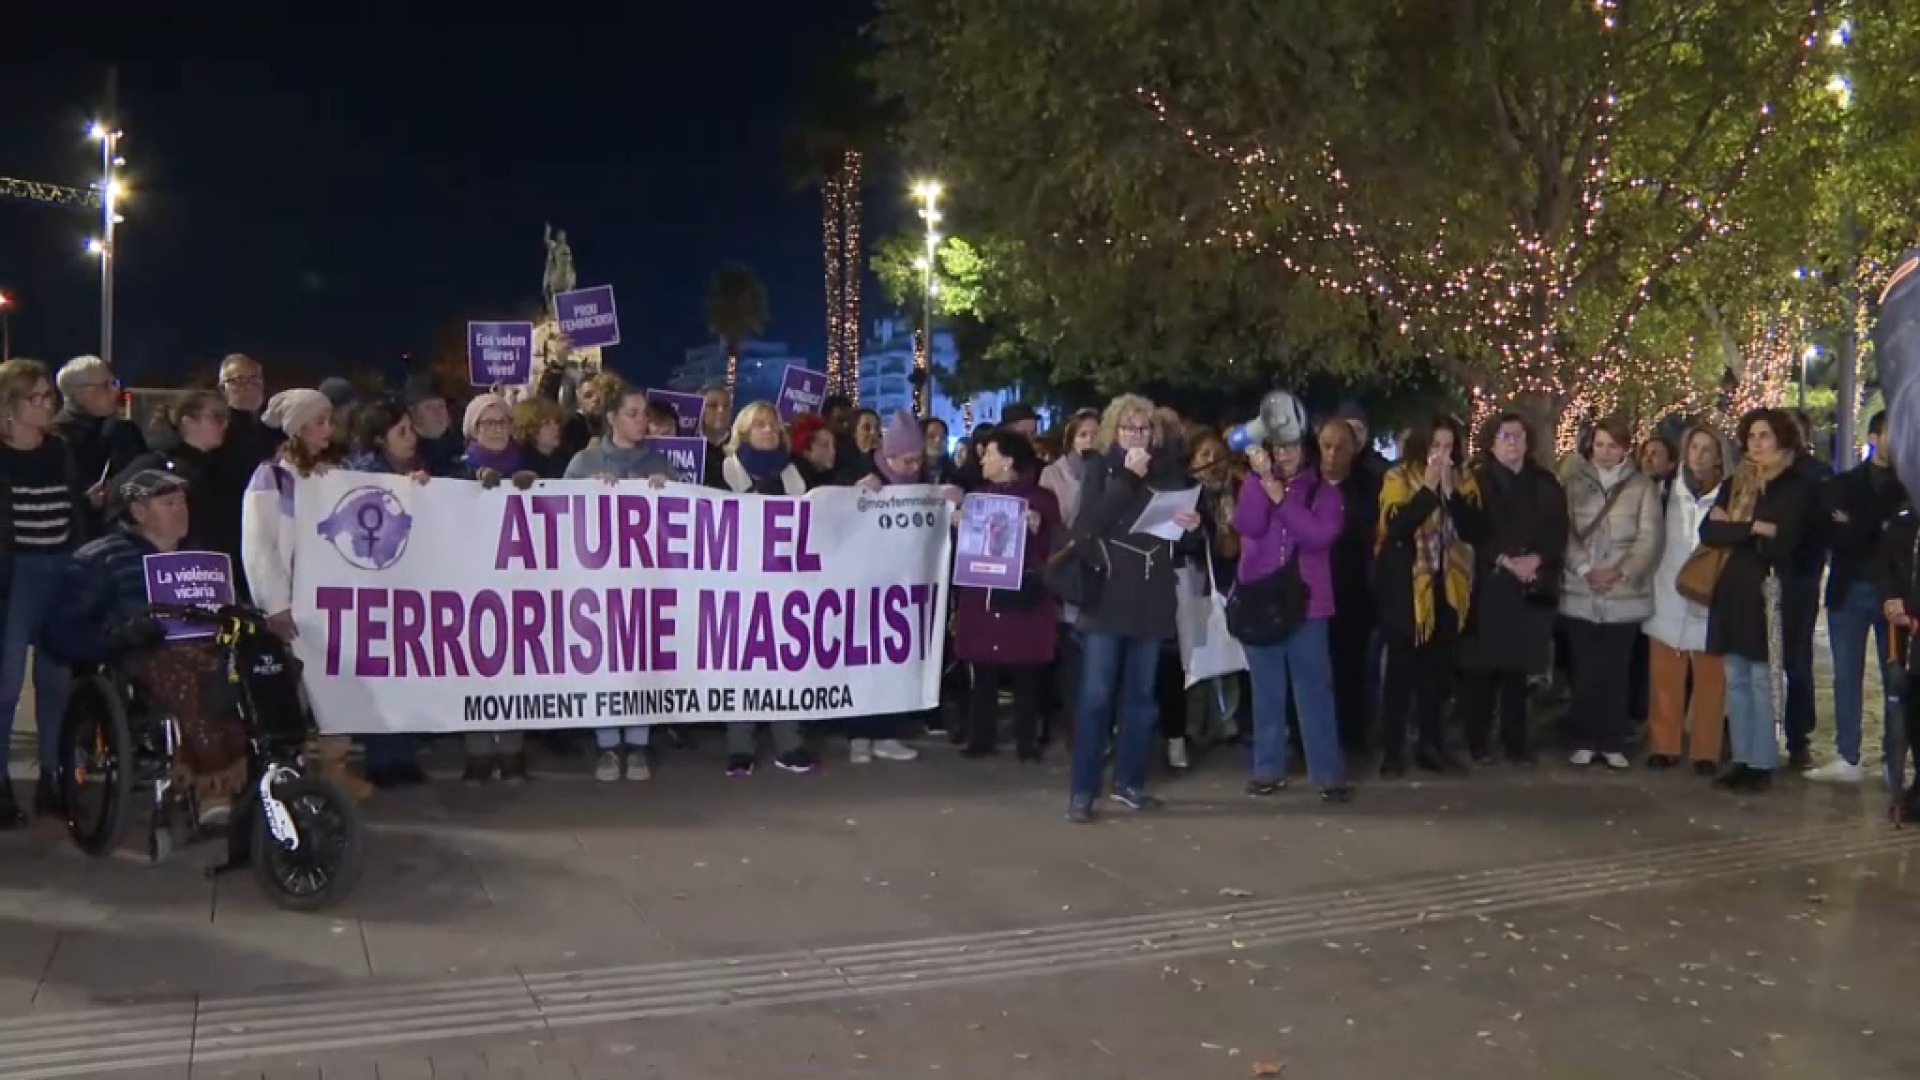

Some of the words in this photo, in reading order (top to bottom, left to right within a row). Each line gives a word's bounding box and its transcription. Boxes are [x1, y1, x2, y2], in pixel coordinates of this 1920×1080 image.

[495, 333, 526, 346] volem
[494, 494, 739, 571] ATUREM
[762, 499, 822, 572] EL
[157, 569, 173, 584] La
[316, 586, 678, 677] TERRORISME
[464, 692, 587, 720] MOVIMENT
[595, 689, 700, 717] FEMINISTA
[708, 688, 736, 712] DE
[742, 685, 854, 712] MALLORCA
